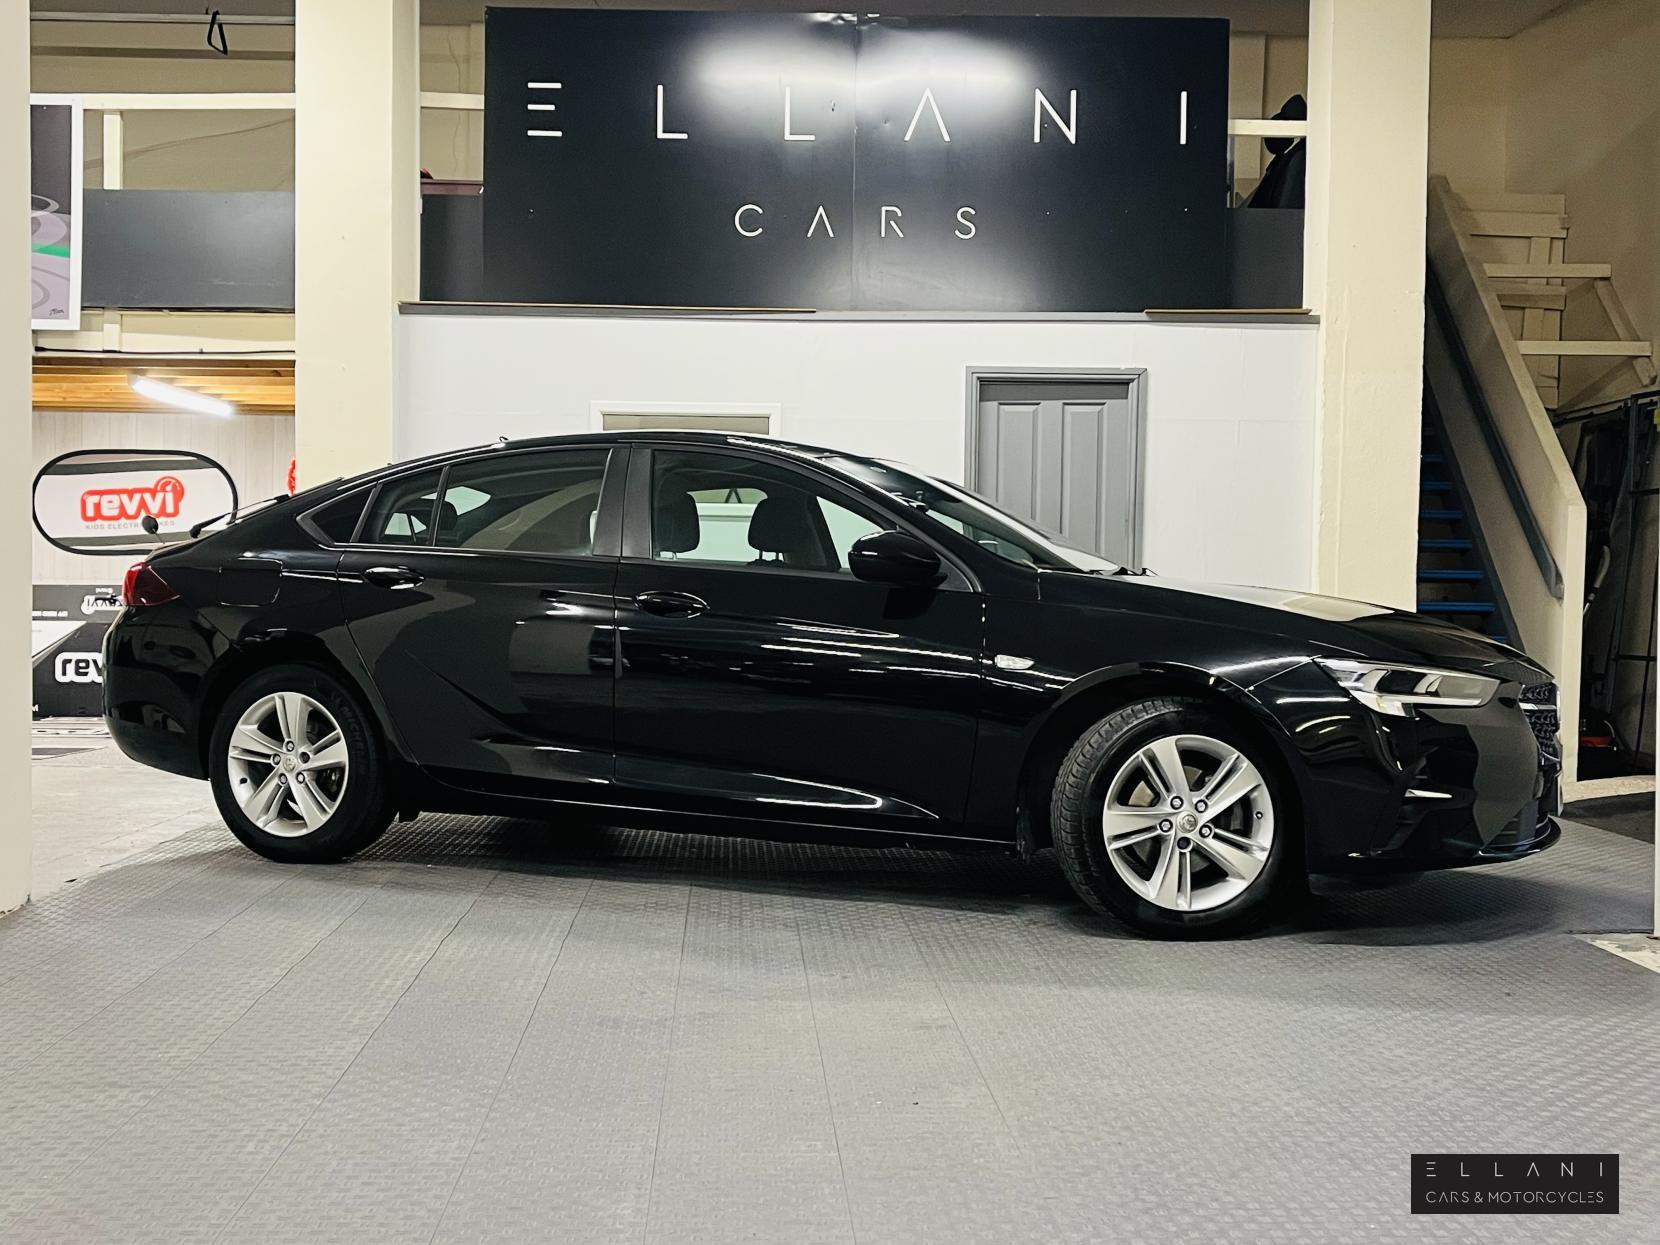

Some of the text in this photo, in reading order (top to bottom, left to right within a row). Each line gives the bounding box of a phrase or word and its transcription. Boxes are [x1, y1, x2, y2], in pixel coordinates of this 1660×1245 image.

[527, 81, 1190, 146] ELLANI
[734, 203, 978, 240] CARS
[85, 480, 175, 518] revvi
[61, 658, 104, 677] rev
